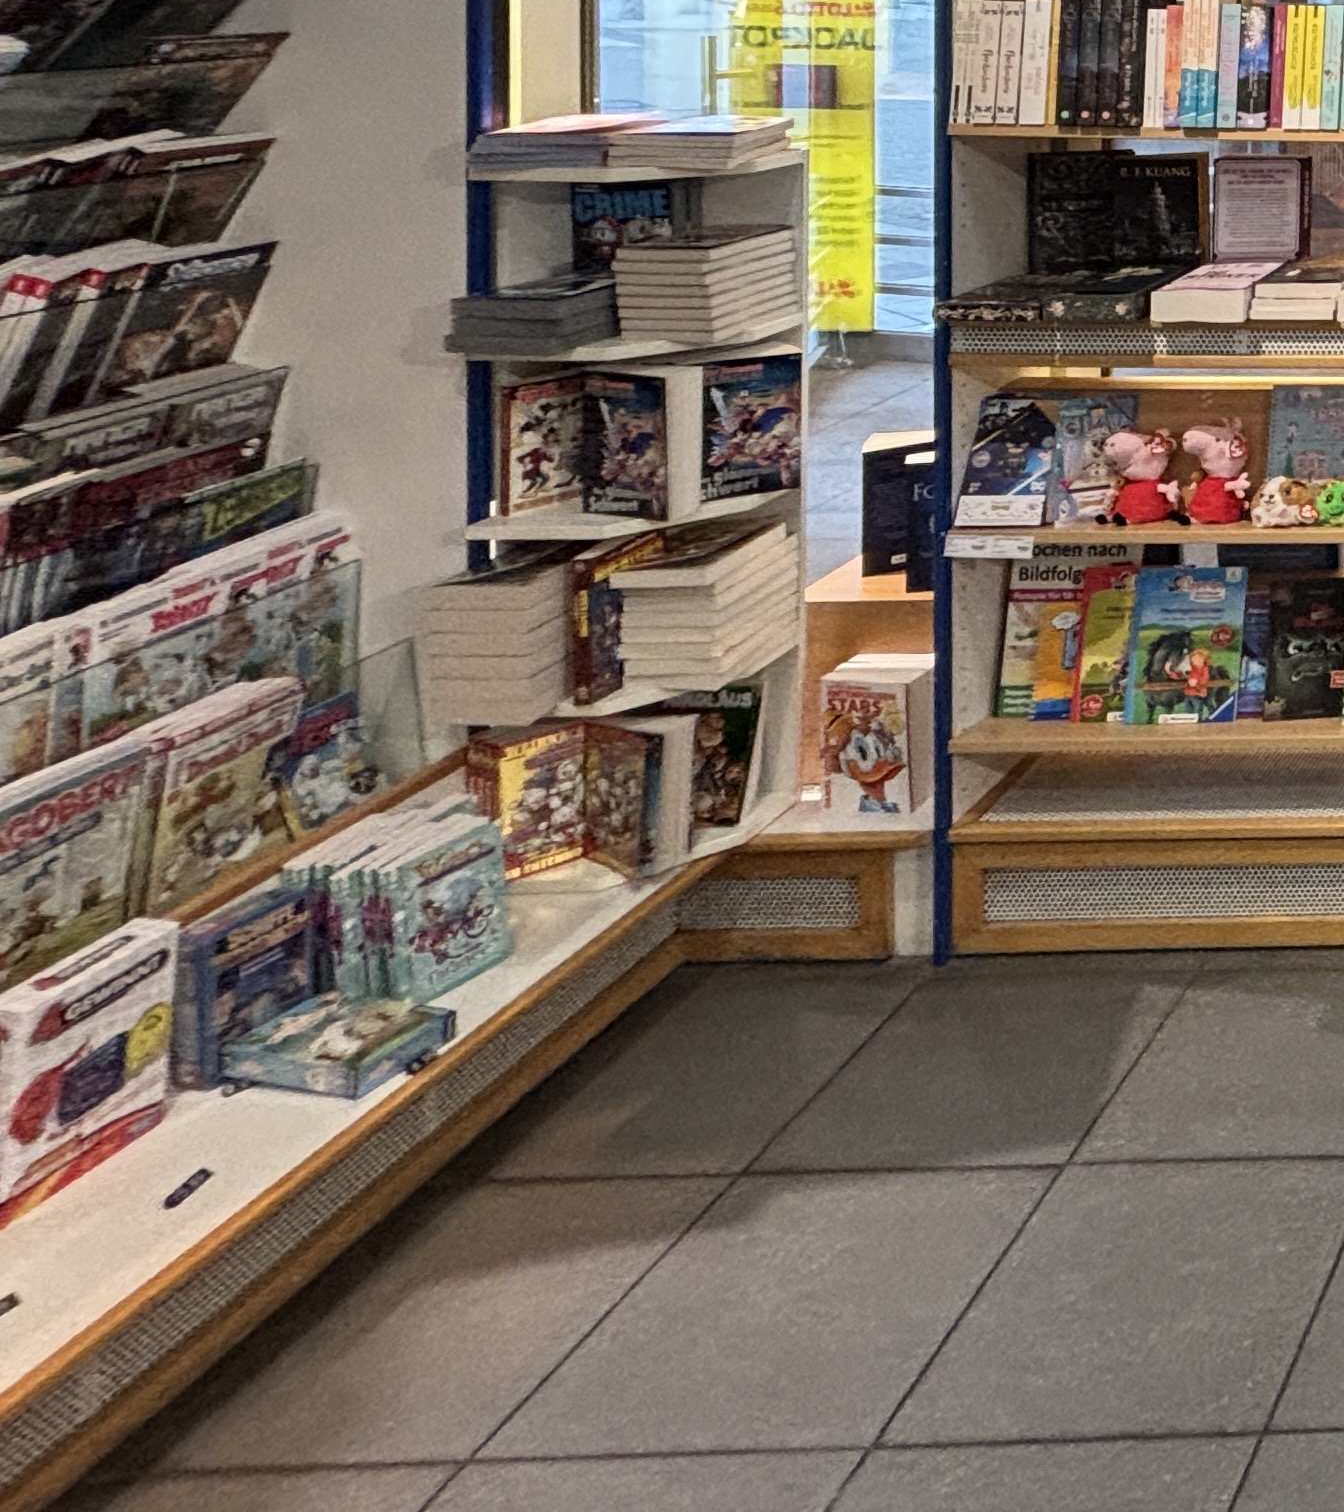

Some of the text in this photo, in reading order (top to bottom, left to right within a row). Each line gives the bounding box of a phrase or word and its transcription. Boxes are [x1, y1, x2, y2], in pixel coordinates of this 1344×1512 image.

[1146, 166, 1192, 177] KUANG
[575, 188, 671, 222] CRIME
[1032, 544, 1127, 558] ochen nach
[1019, 566, 1083, 585] Bildfolg
